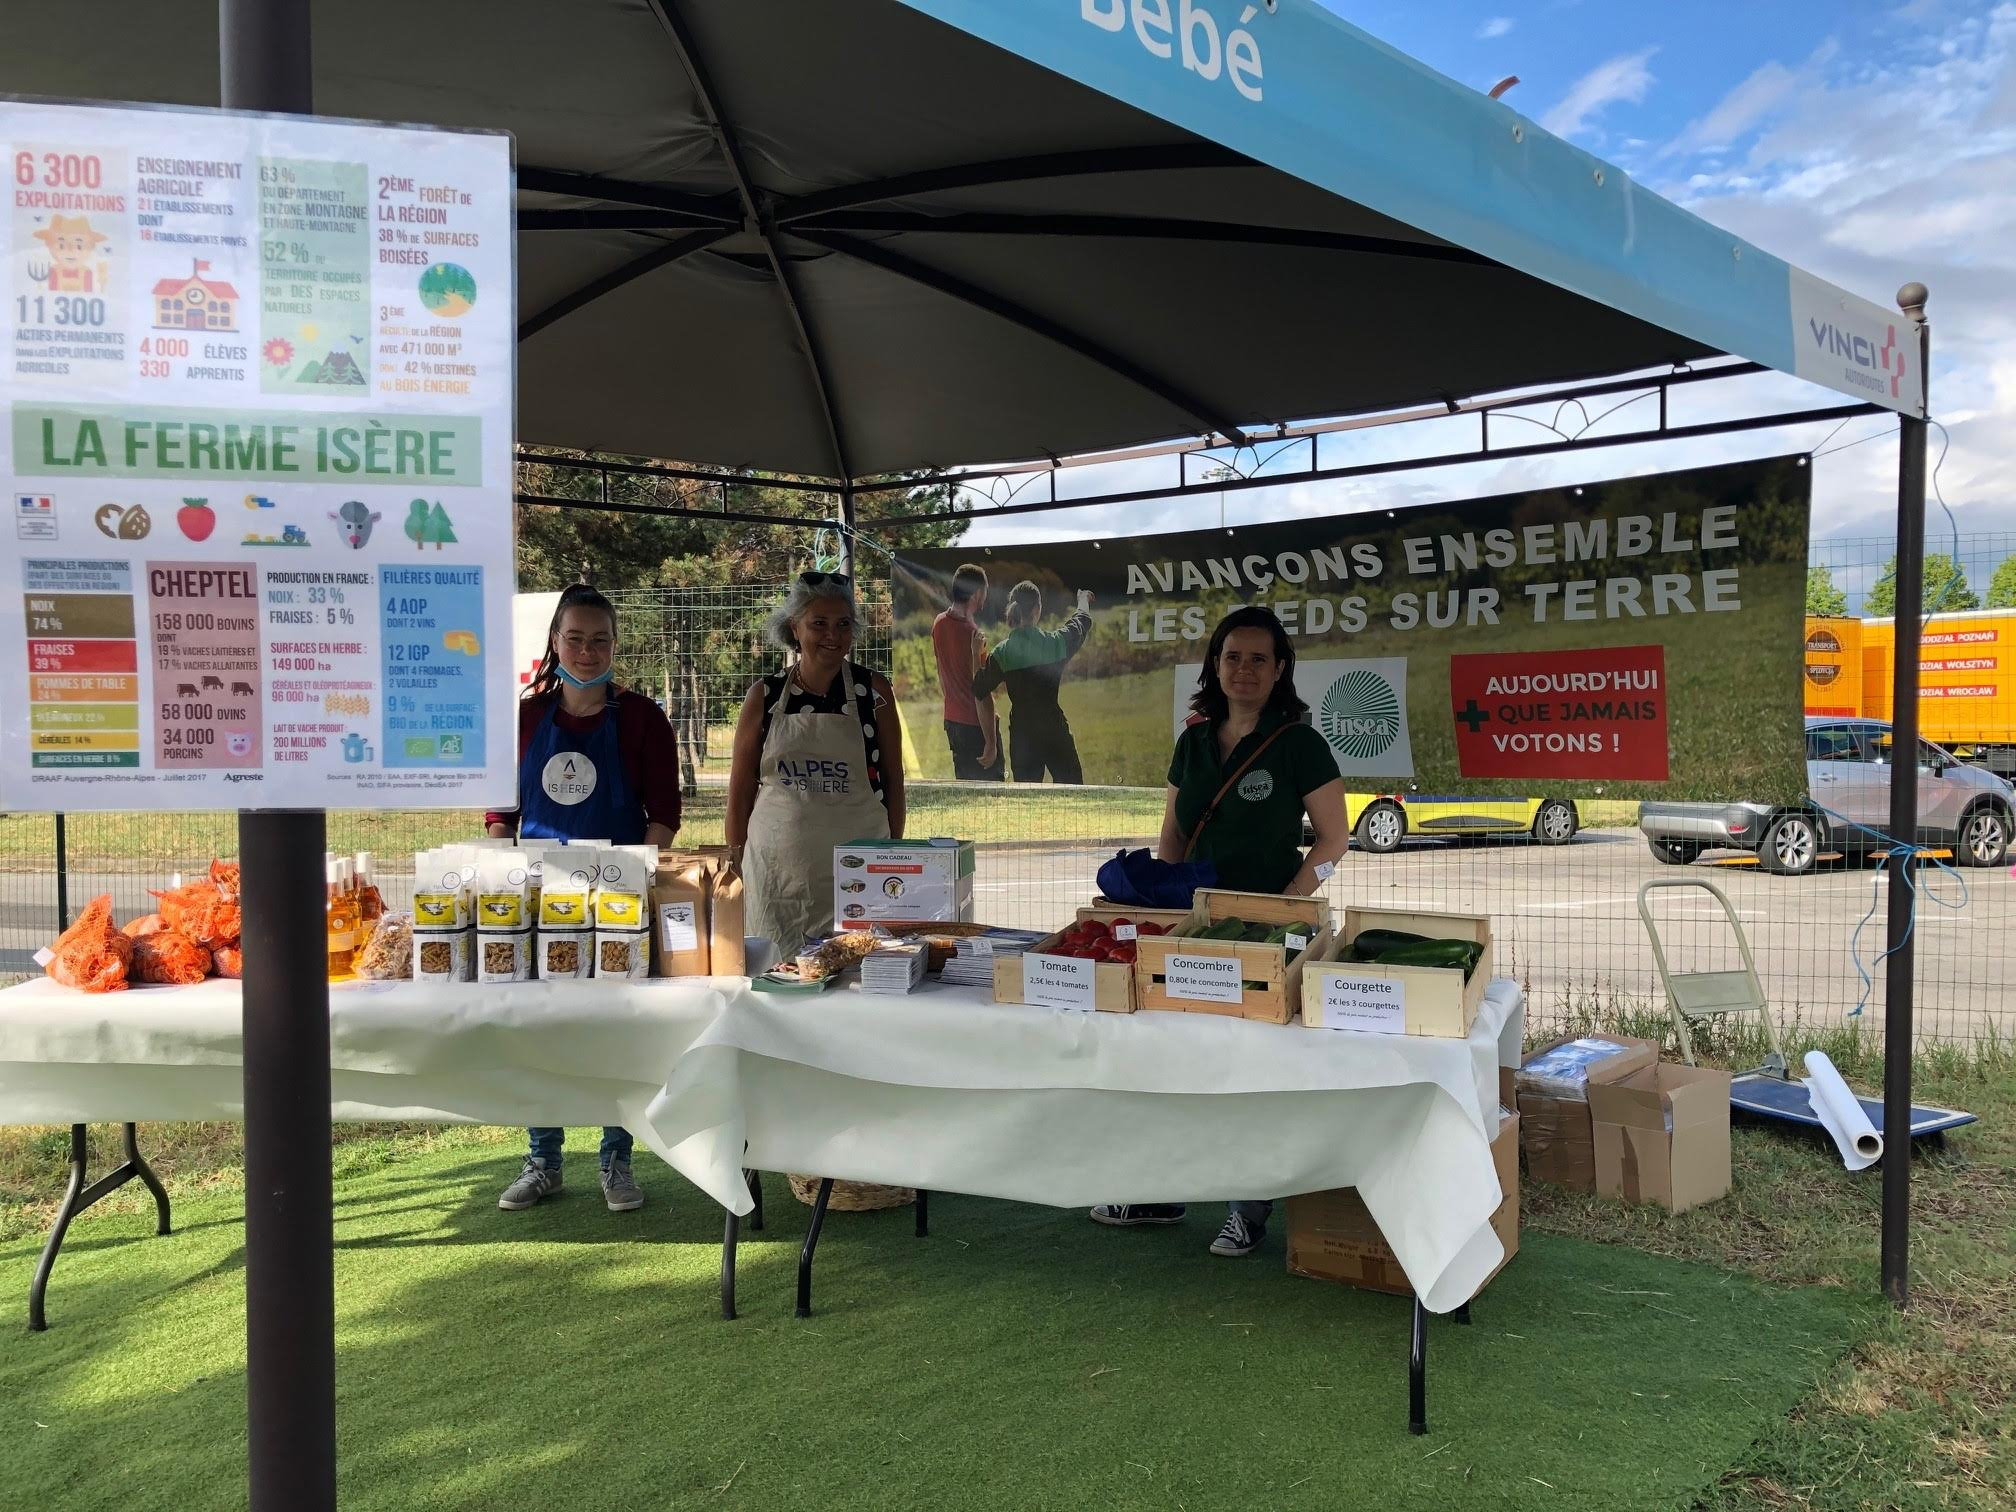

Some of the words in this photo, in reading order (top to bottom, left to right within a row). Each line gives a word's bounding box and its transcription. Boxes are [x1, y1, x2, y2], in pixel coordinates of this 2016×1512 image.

[15, 151, 34, 186] 6
[43, 153, 101, 189] 300
[137, 156, 243, 180] ENSEIGNEMENT
[260, 166, 278, 183] 63
[138, 177, 204, 197] AGRICOLE
[15, 190, 126, 212] EXPLOITATIONS
[419, 186, 459, 205] FORÊT
[461, 193, 473, 206] DE
[263, 202, 275, 215] EN
[278, 203, 303, 216] ZONE
[305, 203, 368, 220] MONTAGNE
[378, 204, 396, 222] LA
[398, 204, 448, 225] RÉGION
[138, 214, 163, 226] DONT
[277, 217, 357, 233] HAUTE-MONTAGNE
[378, 228, 394, 243] 38
[410, 234, 421, 244] DE
[423, 231, 480, 248] SURFACES
[264, 240, 287, 262] 52
[290, 242, 309, 264] %
[379, 248, 429, 266] BOISÉES
[265, 268, 319, 283] TERRITOIRE
[291, 284, 313, 299] DES
[320, 288, 361, 302] ESPACES
[16, 294, 45, 324] 11
[54, 296, 104, 326] 300
[264, 301, 313, 315] NATURELS
[16, 328, 51, 342] ACTIFS
[54, 330, 125, 345] PERMANENTS
[430, 324, 462, 338] RÉGION
[156, 338, 189, 357] 000
[204, 341, 247, 361] ÉLÈVES
[379, 344, 398, 354] AVEC
[401, 341, 421, 355] 471
[425, 343, 445, 356] 000
[1809, 317, 1877, 371] VINCI
[49, 346, 125, 361] EXPLOITATIONS
[15, 361, 70, 375] AGRICOLES
[140, 360, 170, 378] 330
[186, 366, 245, 381] APPRENTIS
[404, 361, 418, 374] 42
[394, 378, 420, 393] BOIS
[423, 379, 472, 395] ÉNERGIE
[1845, 367, 1885, 394] AUTOROUTES
[42, 417, 107, 467] LA
[124, 420, 300, 473] FERME
[316, 419, 455, 476] ISÈRE
[1126, 543, 1384, 595] AVANÇONS
[1402, 504, 1740, 575] ENSEMBLE
[28, 559, 77, 570] PRINCIPALES
[78, 561, 129, 571] PRODUCTIONS
[150, 569, 257, 598] CHEPTEL
[266, 572, 321, 584] PRODUCTION
[322, 573, 334, 585] EN
[383, 568, 432, 585] FILIÈRES
[307, 587, 327, 604] 33
[329, 587, 345, 605] %
[31, 600, 56, 612] NOIX
[386, 597, 397, 615] 4
[399, 598, 428, 615] AOP
[1128, 606, 1207, 643] LES
[1228, 597, 1368, 646] EDS
[1390, 587, 1501, 631] SUR
[1524, 568, 1741, 623] TERRE
[33, 617, 49, 631] 74
[155, 612, 182, 630] 158
[185, 613, 214, 631] 000
[217, 618, 256, 631] BOVINS
[327, 608, 337, 625] 5
[339, 608, 355, 625] %
[387, 618, 409, 629] DONT
[417, 618, 437, 629] VINS
[156, 632, 177, 643] DONT
[1957, 632, 1994, 641] POZNAŃ
[34, 643, 76, 656] FRAISES
[182, 647, 211, 657] VACHES
[270, 642, 318, 654] SURFACES
[318, 642, 331, 654] EN
[388, 644, 405, 661] 12
[407, 644, 431, 661] IGP
[1807, 642, 1838, 650] TRANSPORT
[35, 657, 49, 669] 39
[183, 661, 212, 671] VACHES
[212, 661, 259, 671] ALLAITANTES
[272, 658, 292, 671] 149
[294, 658, 316, 671] 000
[318, 661, 333, 671] ha
[388, 665, 409, 676] DONT
[1946, 659, 1994, 670] WOLSZTYN
[37, 678, 80, 690] POMMES
[81, 678, 94, 690] DE
[97, 678, 127, 690] TABLE
[397, 678, 438, 689] VOLAILLES
[271, 691, 284, 703] 96
[286, 691, 304, 703] 000
[306, 693, 320, 703] ha
[1946, 687, 1994, 697] WROCŁAW
[161, 703, 181, 720] 58
[184, 703, 213, 720] 000
[217, 708, 247, 721] OVINS
[388, 696, 398, 713] 9
[1498, 703, 1553, 725] QUE
[1560, 700, 1657, 722] JAMAIS
[273, 724, 288, 733] LAIT
[288, 724, 297, 733] DE
[297, 724, 318, 733] VACHE
[389, 716, 407, 730] BIO
[1330, 710, 1391, 737] fnsea
[163, 728, 183, 745] 34
[186, 728, 215, 745] 000
[273, 736, 290, 748] 200
[290, 736, 328, 748] MILLIONS
[1492, 733, 1603, 753] VOTONS
[163, 748, 204, 760] PORCINS
[274, 751, 284, 762] DE
[284, 751, 309, 762] LITRES
[777, 760, 849, 779] ALPES
[186, 773, 207, 782] 2017
[223, 772, 264, 784] Agreste
[1040, 960, 1078, 974] Tomate
[1172, 957, 1234, 973] Concombre
[1030, 976, 1045, 986] 2,5€
[1045, 977, 1055, 986] les
[1061, 981, 1089, 990] tomates
[1190, 978, 1198, 986] le
[1198, 978, 1239, 990] concombre
[1334, 979, 1392, 994] Courgette
[1328, 997, 1338, 1006] 2€
[1339, 998, 1350, 1007] les
[1358, 1001, 1400, 1011] courgettes
